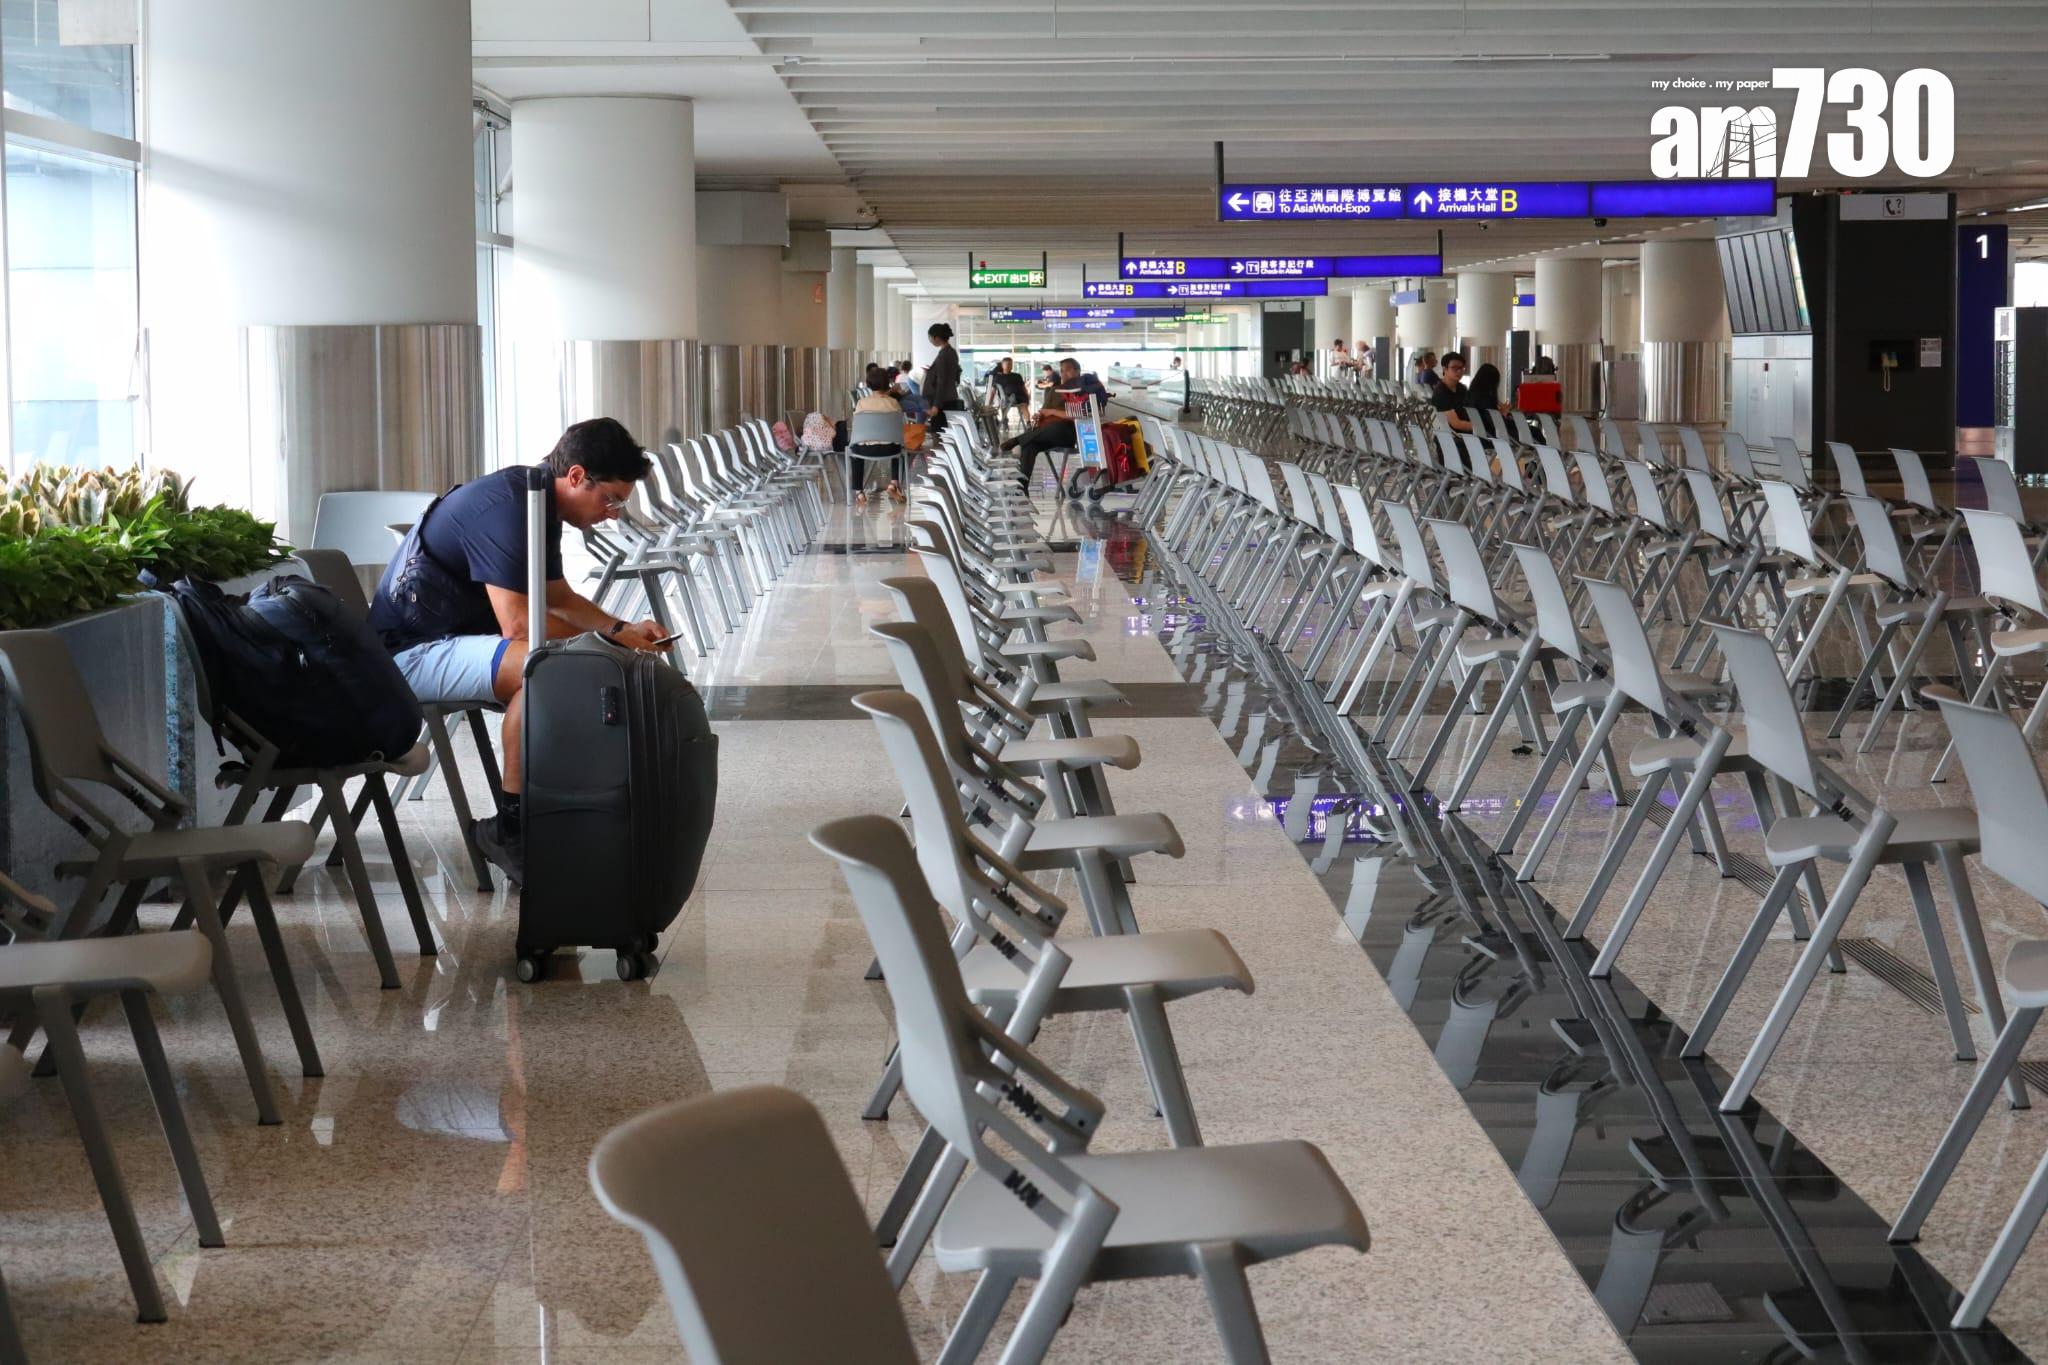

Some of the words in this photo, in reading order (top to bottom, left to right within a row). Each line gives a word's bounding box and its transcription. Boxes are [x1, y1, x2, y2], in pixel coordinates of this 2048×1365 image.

[1279, 188, 1402, 203] 往亞洲國際博覽館
[1438, 187, 1498, 202] 接機大堂
[1501, 189, 1518, 212] B
[1279, 203, 1291, 213] To
[1292, 203, 1371, 215] AsiaWorld-Expo
[1438, 202, 1476, 213] Arrivals
[1477, 202, 1496, 213] Hall
[1975, 234, 1988, 259] 1
[1176, 261, 1185, 275] B
[984, 273, 1009, 284] EXIT
[1010, 273, 1029, 284] 出口
[1126, 284, 1133, 295] B
